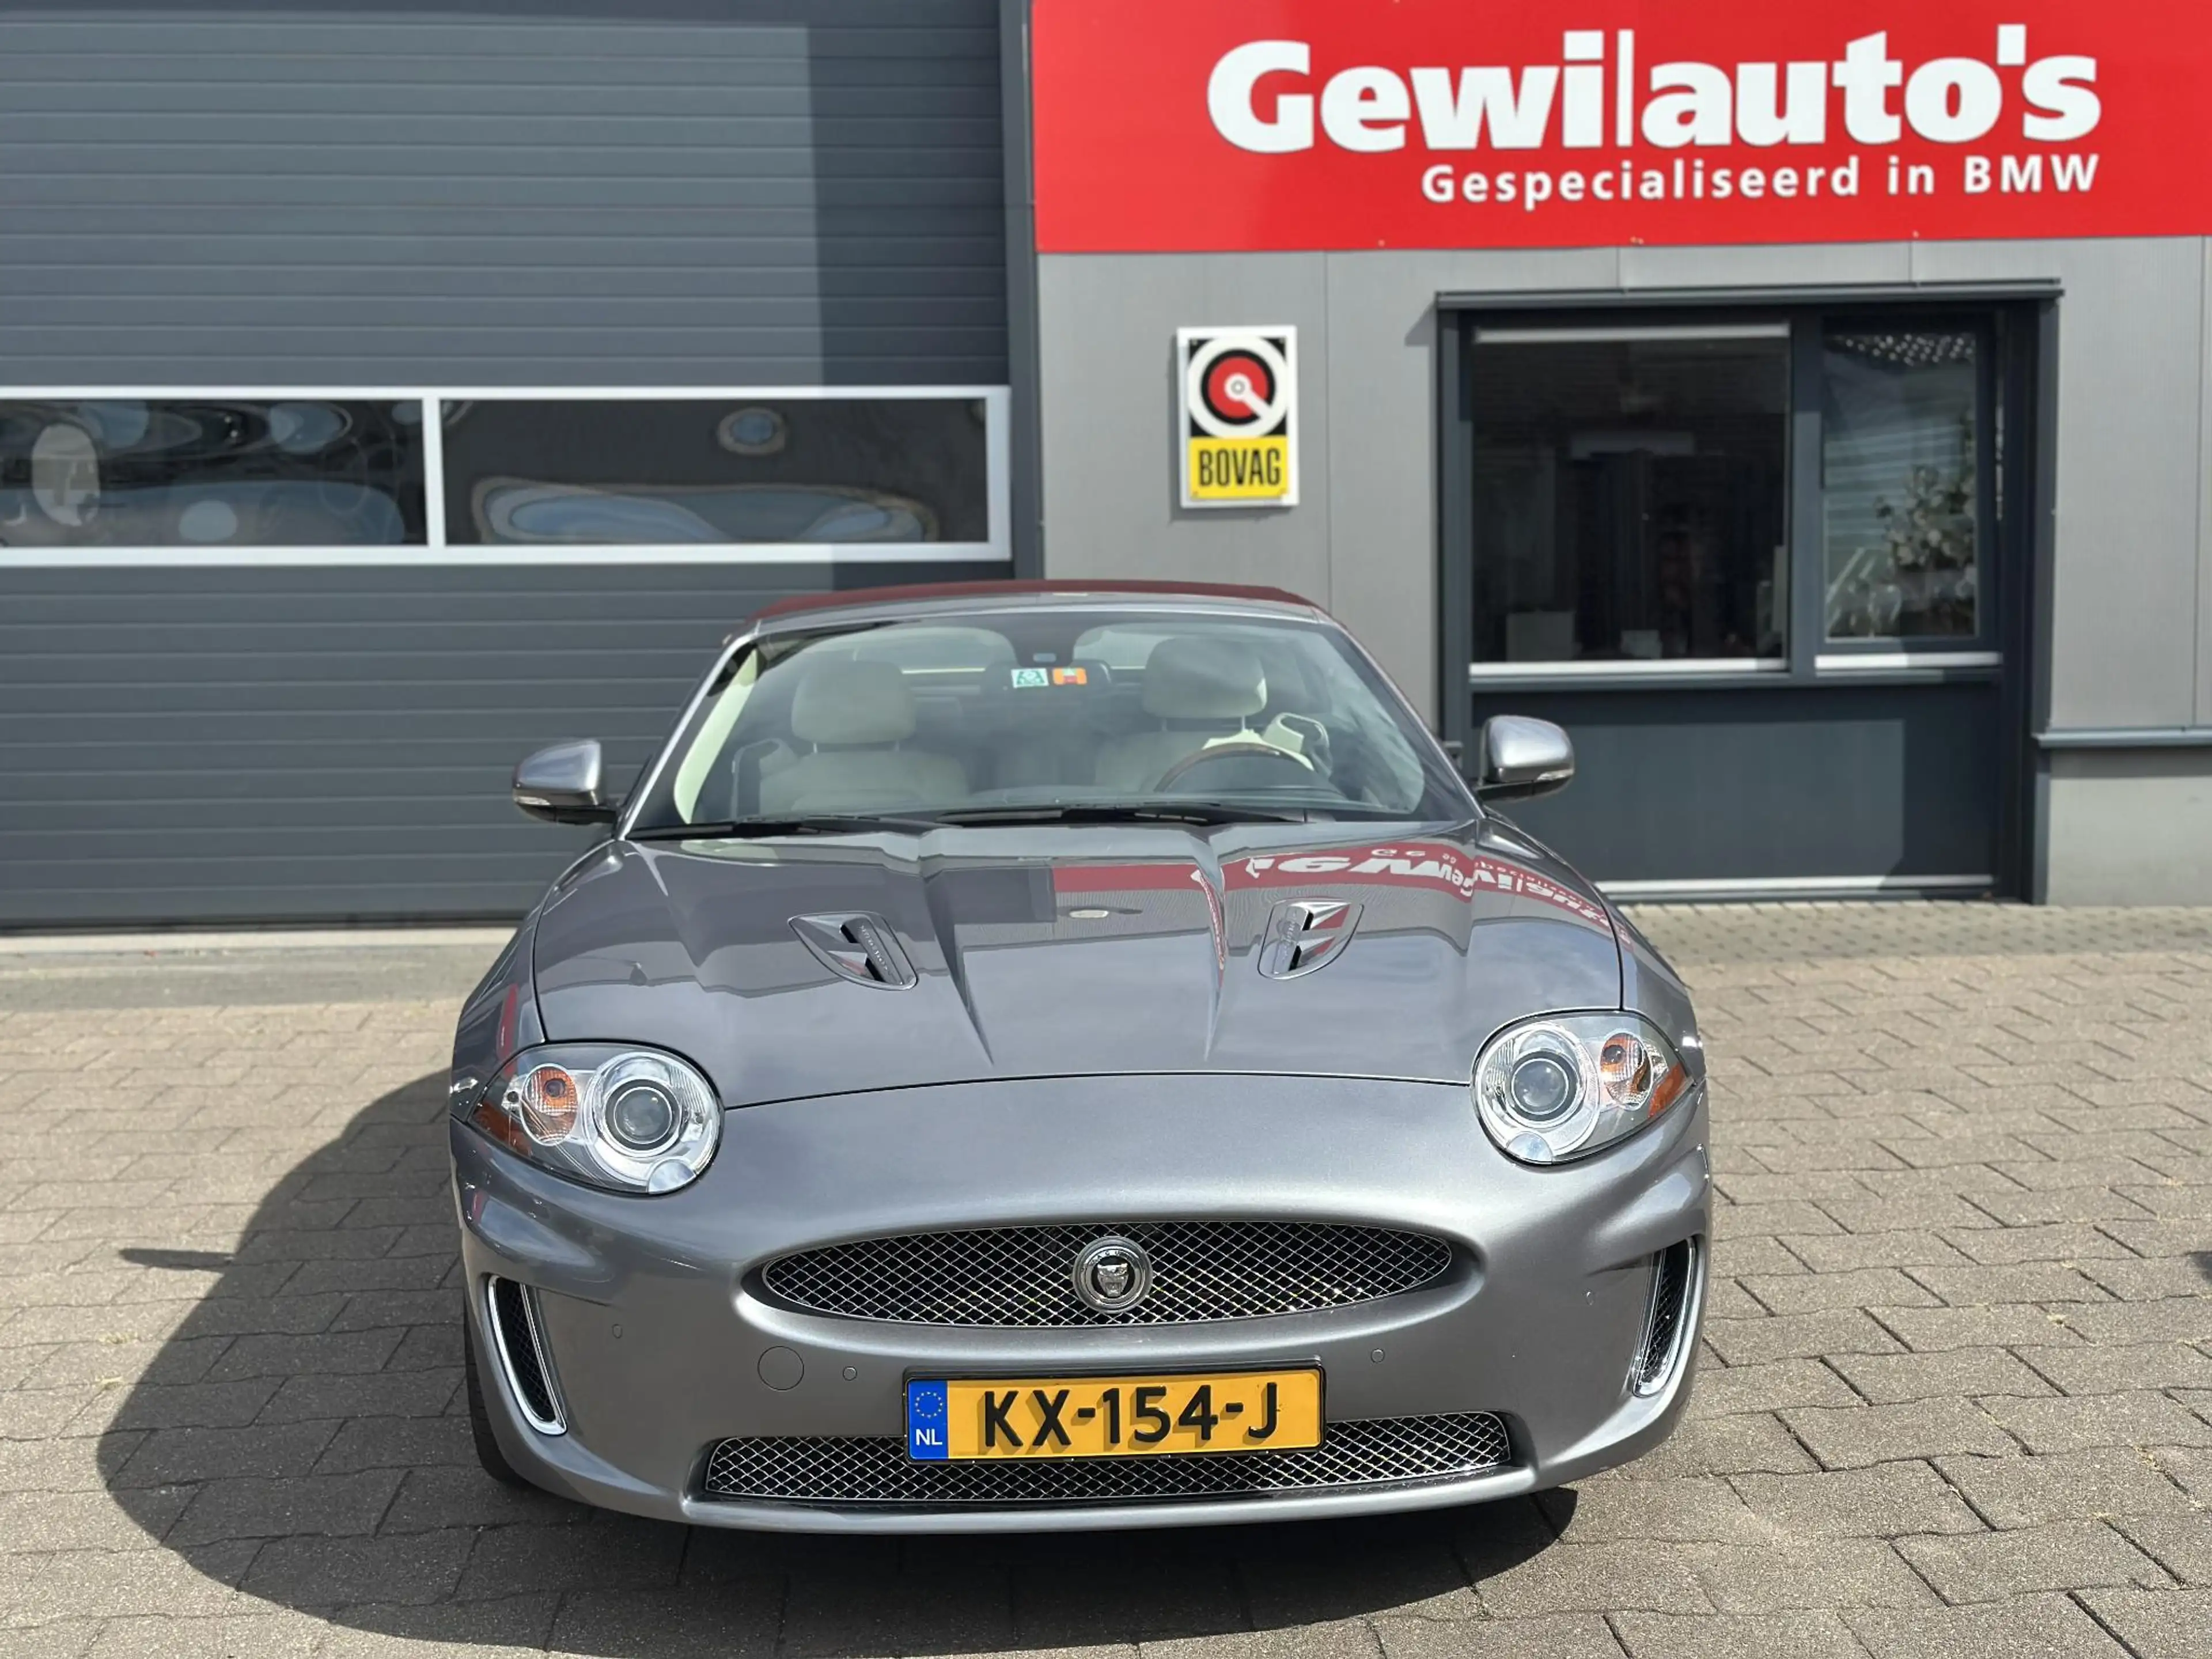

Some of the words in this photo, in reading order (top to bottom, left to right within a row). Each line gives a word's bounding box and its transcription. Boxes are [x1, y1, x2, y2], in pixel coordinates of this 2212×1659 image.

[1422, 156, 1858, 211] Gespecialiseerd
[1888, 155, 1934, 194] in
[1965, 154, 2099, 193] BMW
[1199, 448, 1280, 486] BOVAG
[916, 1429, 943, 1445] NL
[984, 1382, 1277, 1447] KX-154-J
